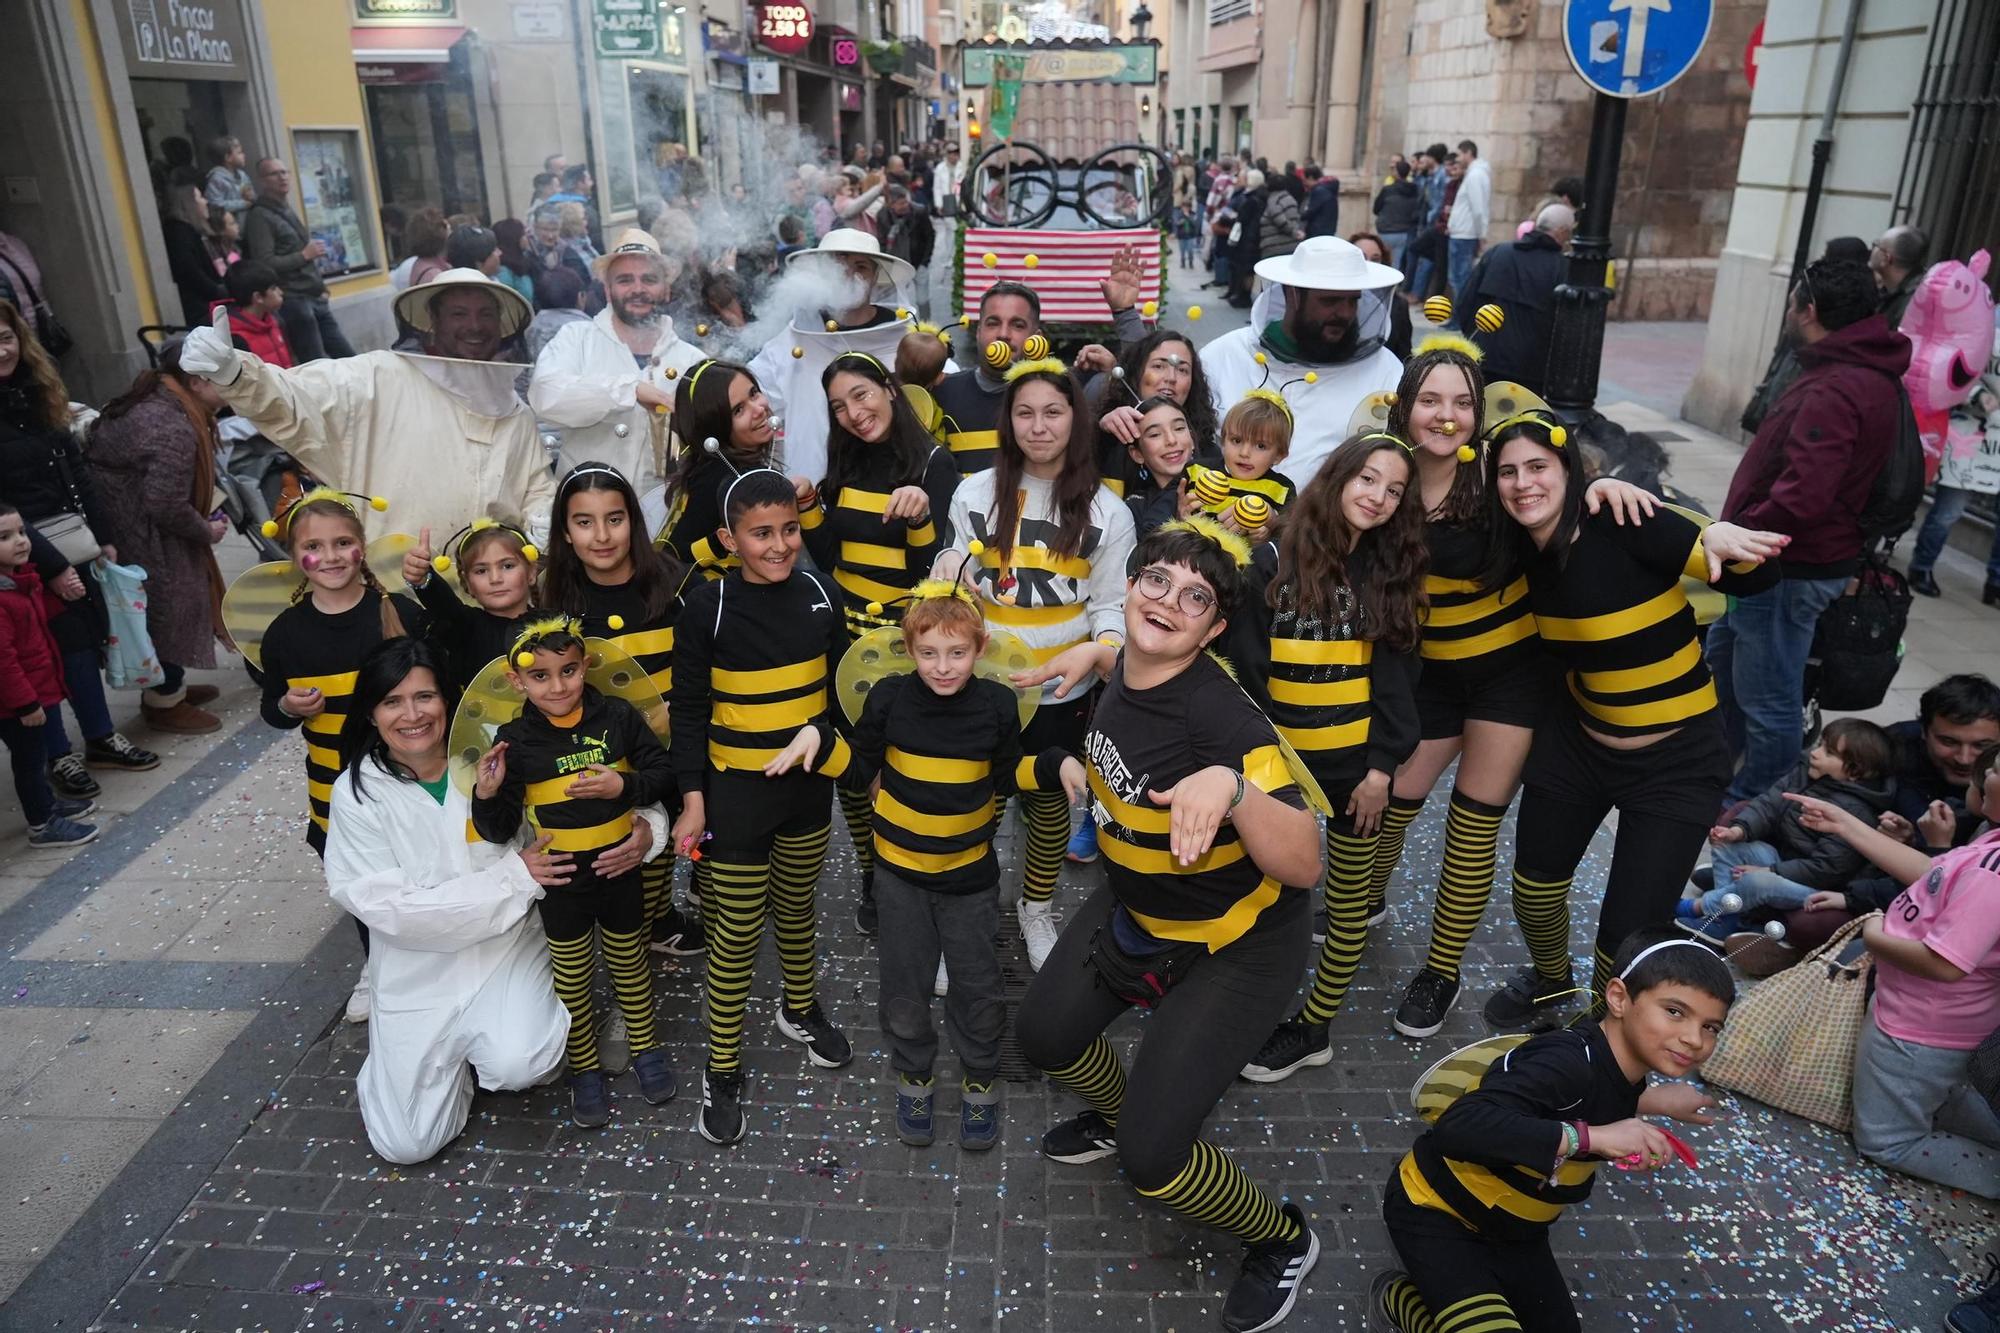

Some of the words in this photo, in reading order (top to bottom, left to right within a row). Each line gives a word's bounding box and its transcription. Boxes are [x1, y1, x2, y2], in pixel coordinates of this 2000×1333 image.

[764, 6, 806, 20] TODO
[163, 26, 185, 59] La
[187, 29, 232, 62] Plana
[556, 748, 605, 773] PUMA
